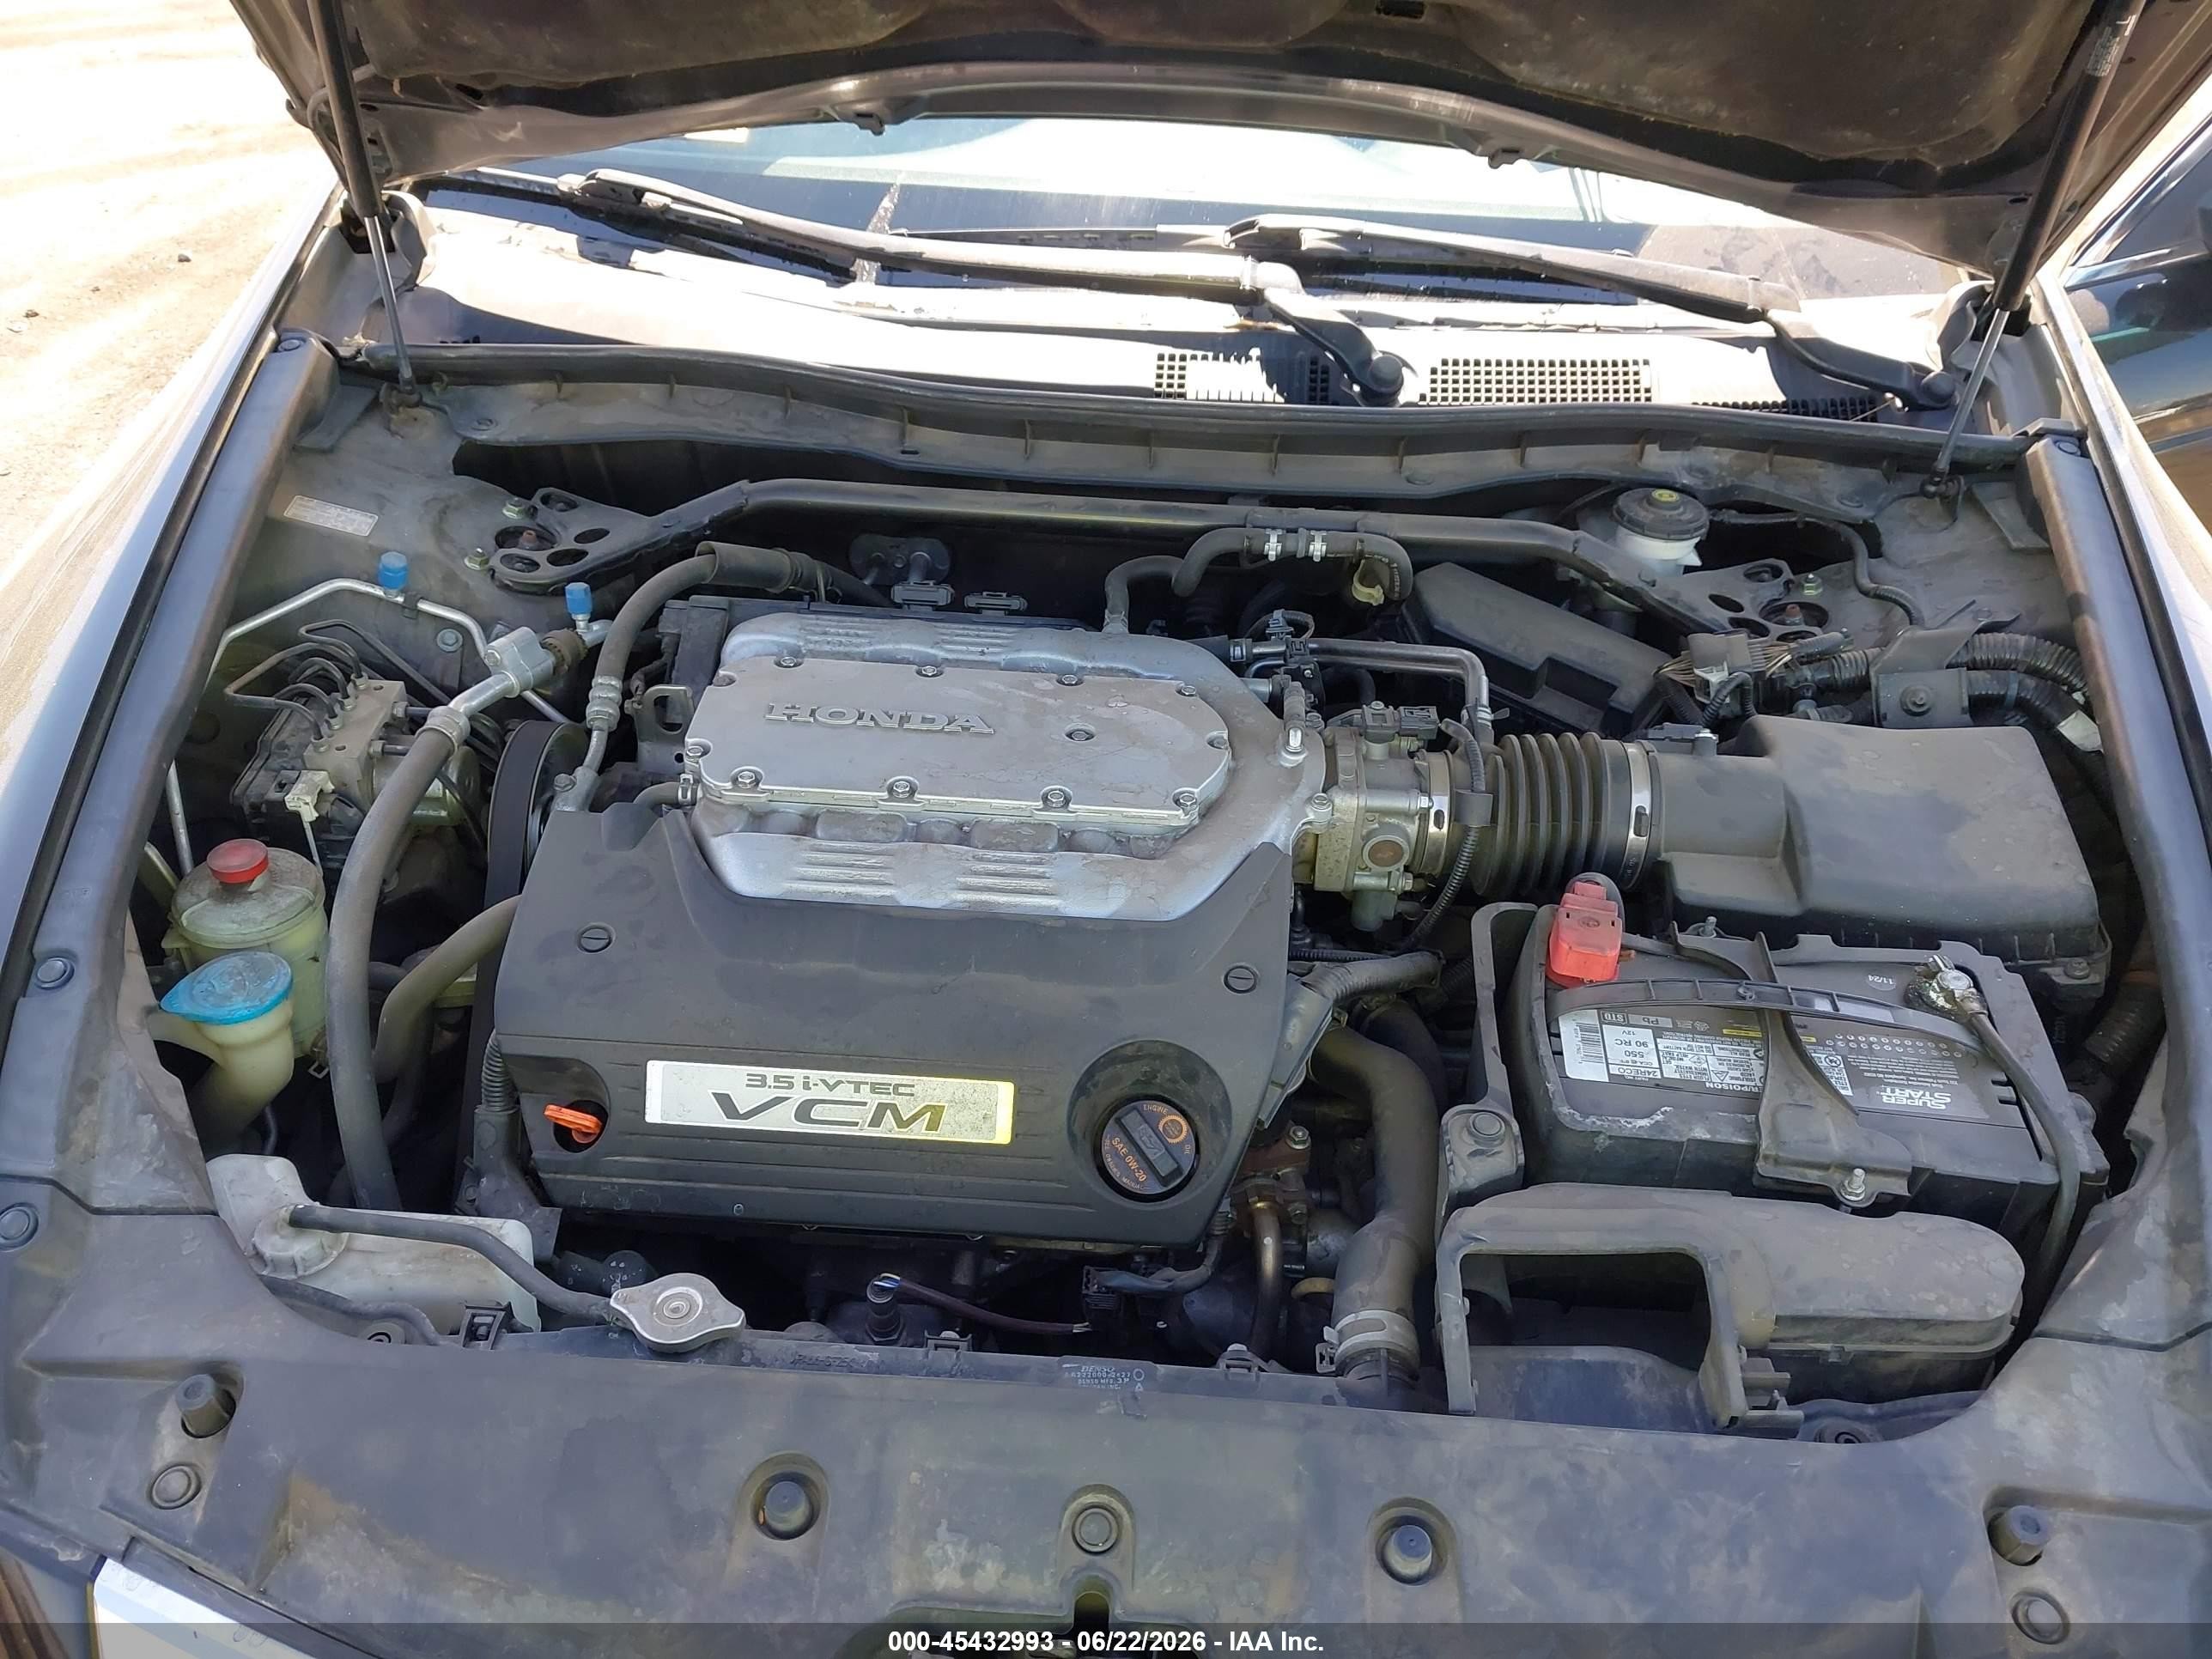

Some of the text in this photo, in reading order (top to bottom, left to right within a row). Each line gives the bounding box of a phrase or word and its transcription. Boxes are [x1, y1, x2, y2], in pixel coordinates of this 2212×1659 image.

[765, 702, 994, 734] HONDA
[1869, 975, 1893, 985] 11/24
[1604, 1013, 1624, 1022] STD
[1642, 1017, 1659, 1025] Pb
[1618, 1067, 1658, 1077] 24RECO
[745, 1073, 915, 1097] 3.5 i-VTEC
[1881, 1087, 1951, 1103] START
[1142, 1103, 1170, 1115] ENGINE
[1881, 1096, 1946, 1109] SUPER
[710, 1091, 947, 1132] VCM
[1112, 1137, 1148, 1182] SAE 0W-20
